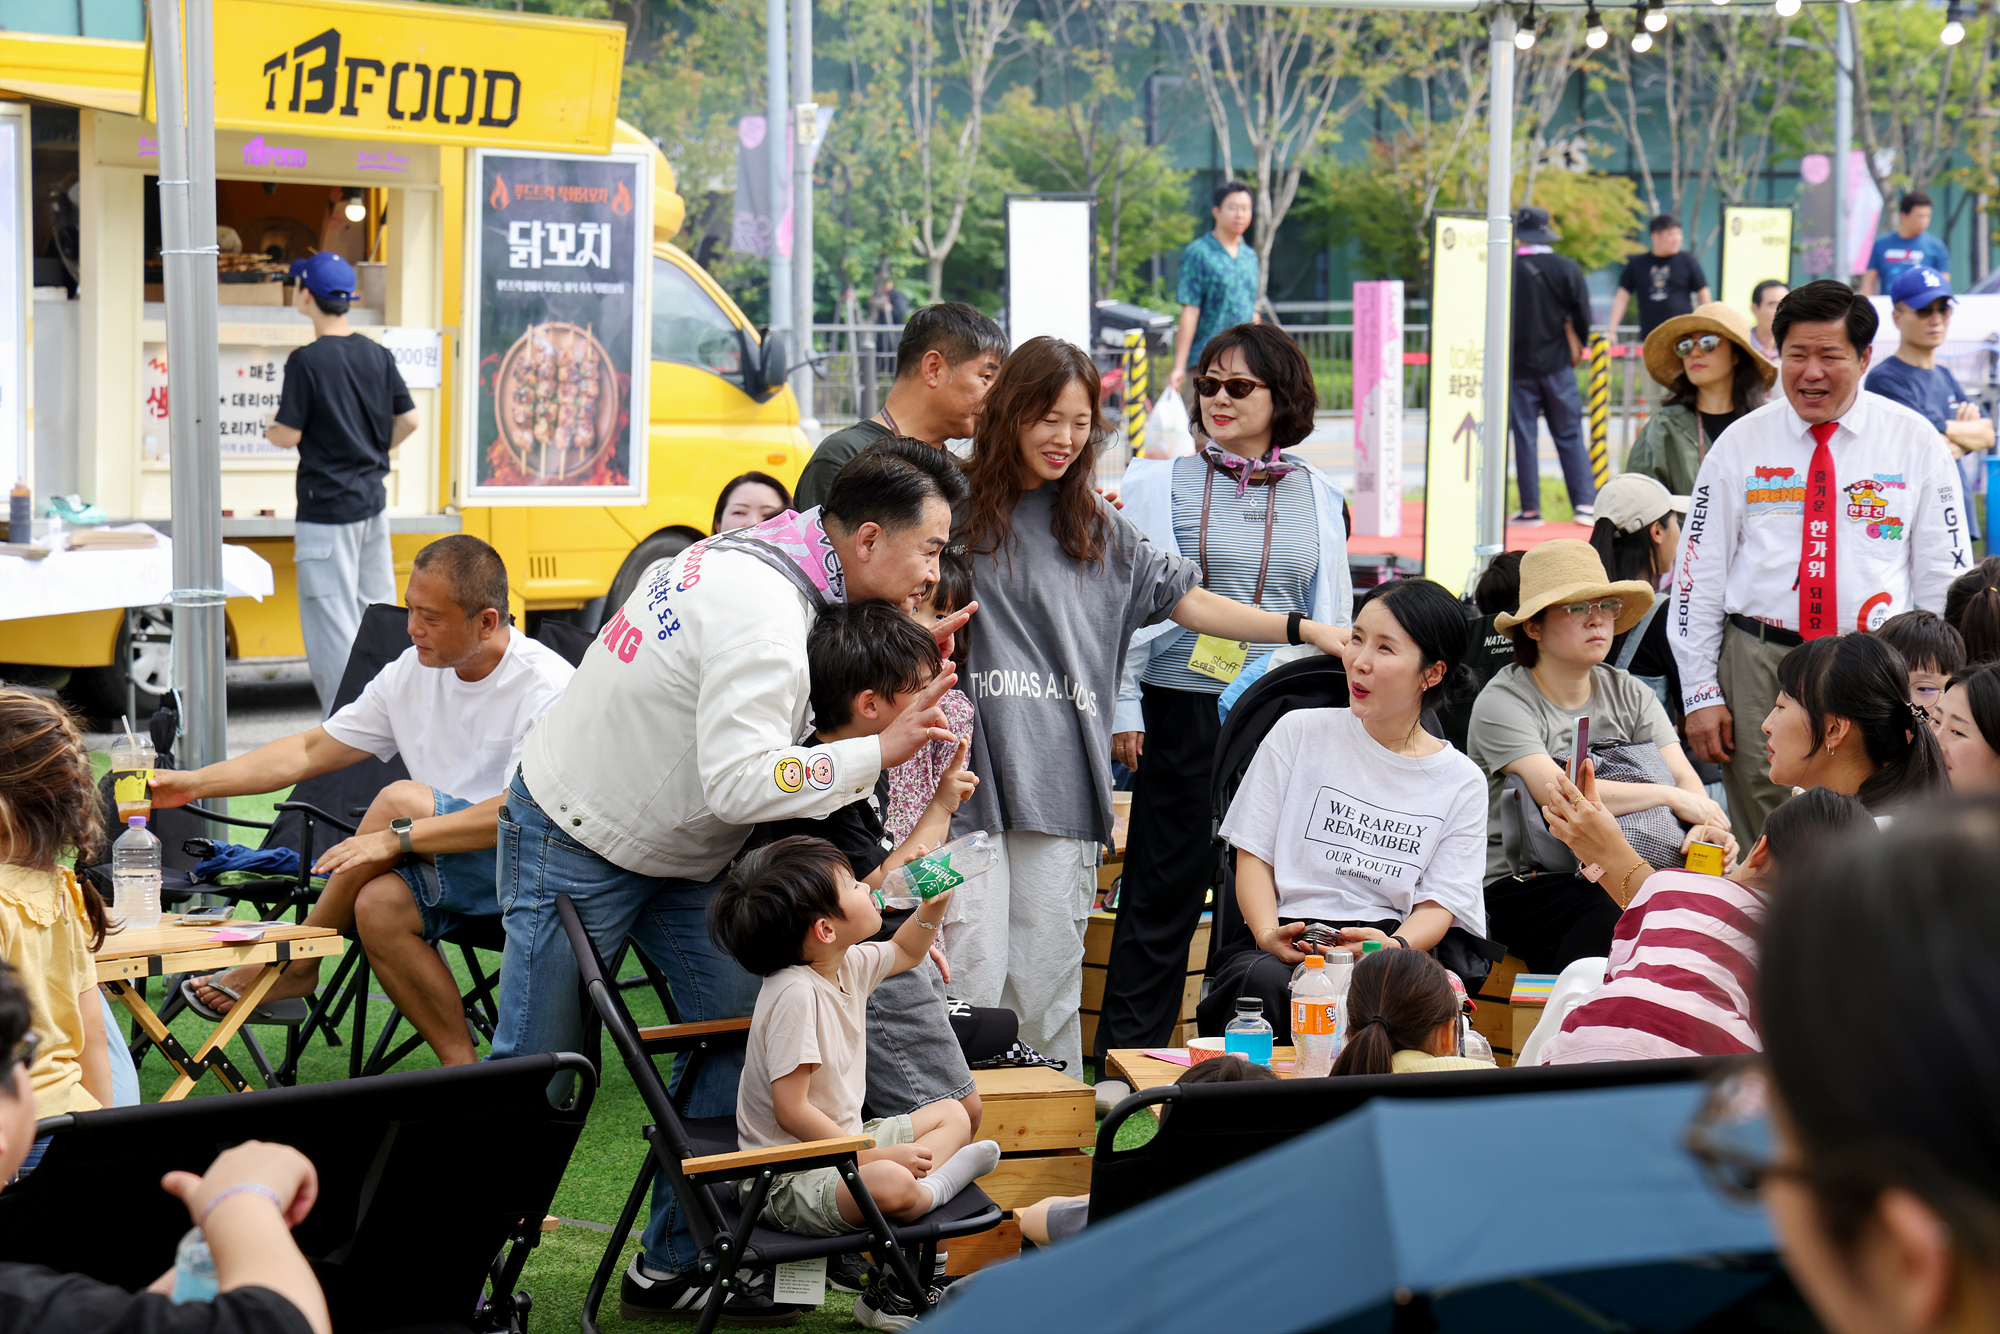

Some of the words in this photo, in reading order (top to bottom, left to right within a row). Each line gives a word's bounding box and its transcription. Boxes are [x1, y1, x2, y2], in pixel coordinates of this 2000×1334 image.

[508, 219, 612, 269] 닭꼬치
[250, 362, 277, 381] 매운
[1746, 487, 1806, 504] ARENA
[1812, 470, 1827, 513] 즐거운
[1937, 486, 1954, 494] SEOUL
[1848, 505, 1884, 517] 안병건
[1866, 524, 1903, 540] GTX
[1944, 507, 1967, 569] GTX
[1679, 583, 1693, 637] SEOUL
[1692, 485, 1710, 545] ARENA
[1808, 519, 1829, 578] 한가위
[1809, 586, 1823, 630] 되세요
[658, 608, 681, 641] 도봉
[1211, 655, 1240, 674] staff
[970, 669, 1042, 699] THOMAS
[1045, 672, 1063, 700] A.
[1329, 800, 1357, 820] WE
[1358, 813, 1429, 839] RARELY
[1322, 817, 1421, 855] REMEMBER
[920, 858, 958, 886] Chilsung
[1325, 849, 1353, 864] OUR
[1356, 857, 1403, 878] YOUTH
[1335, 866, 1347, 877] the
[1348, 869, 1371, 883] follies
[1372, 877, 1383, 886] of
